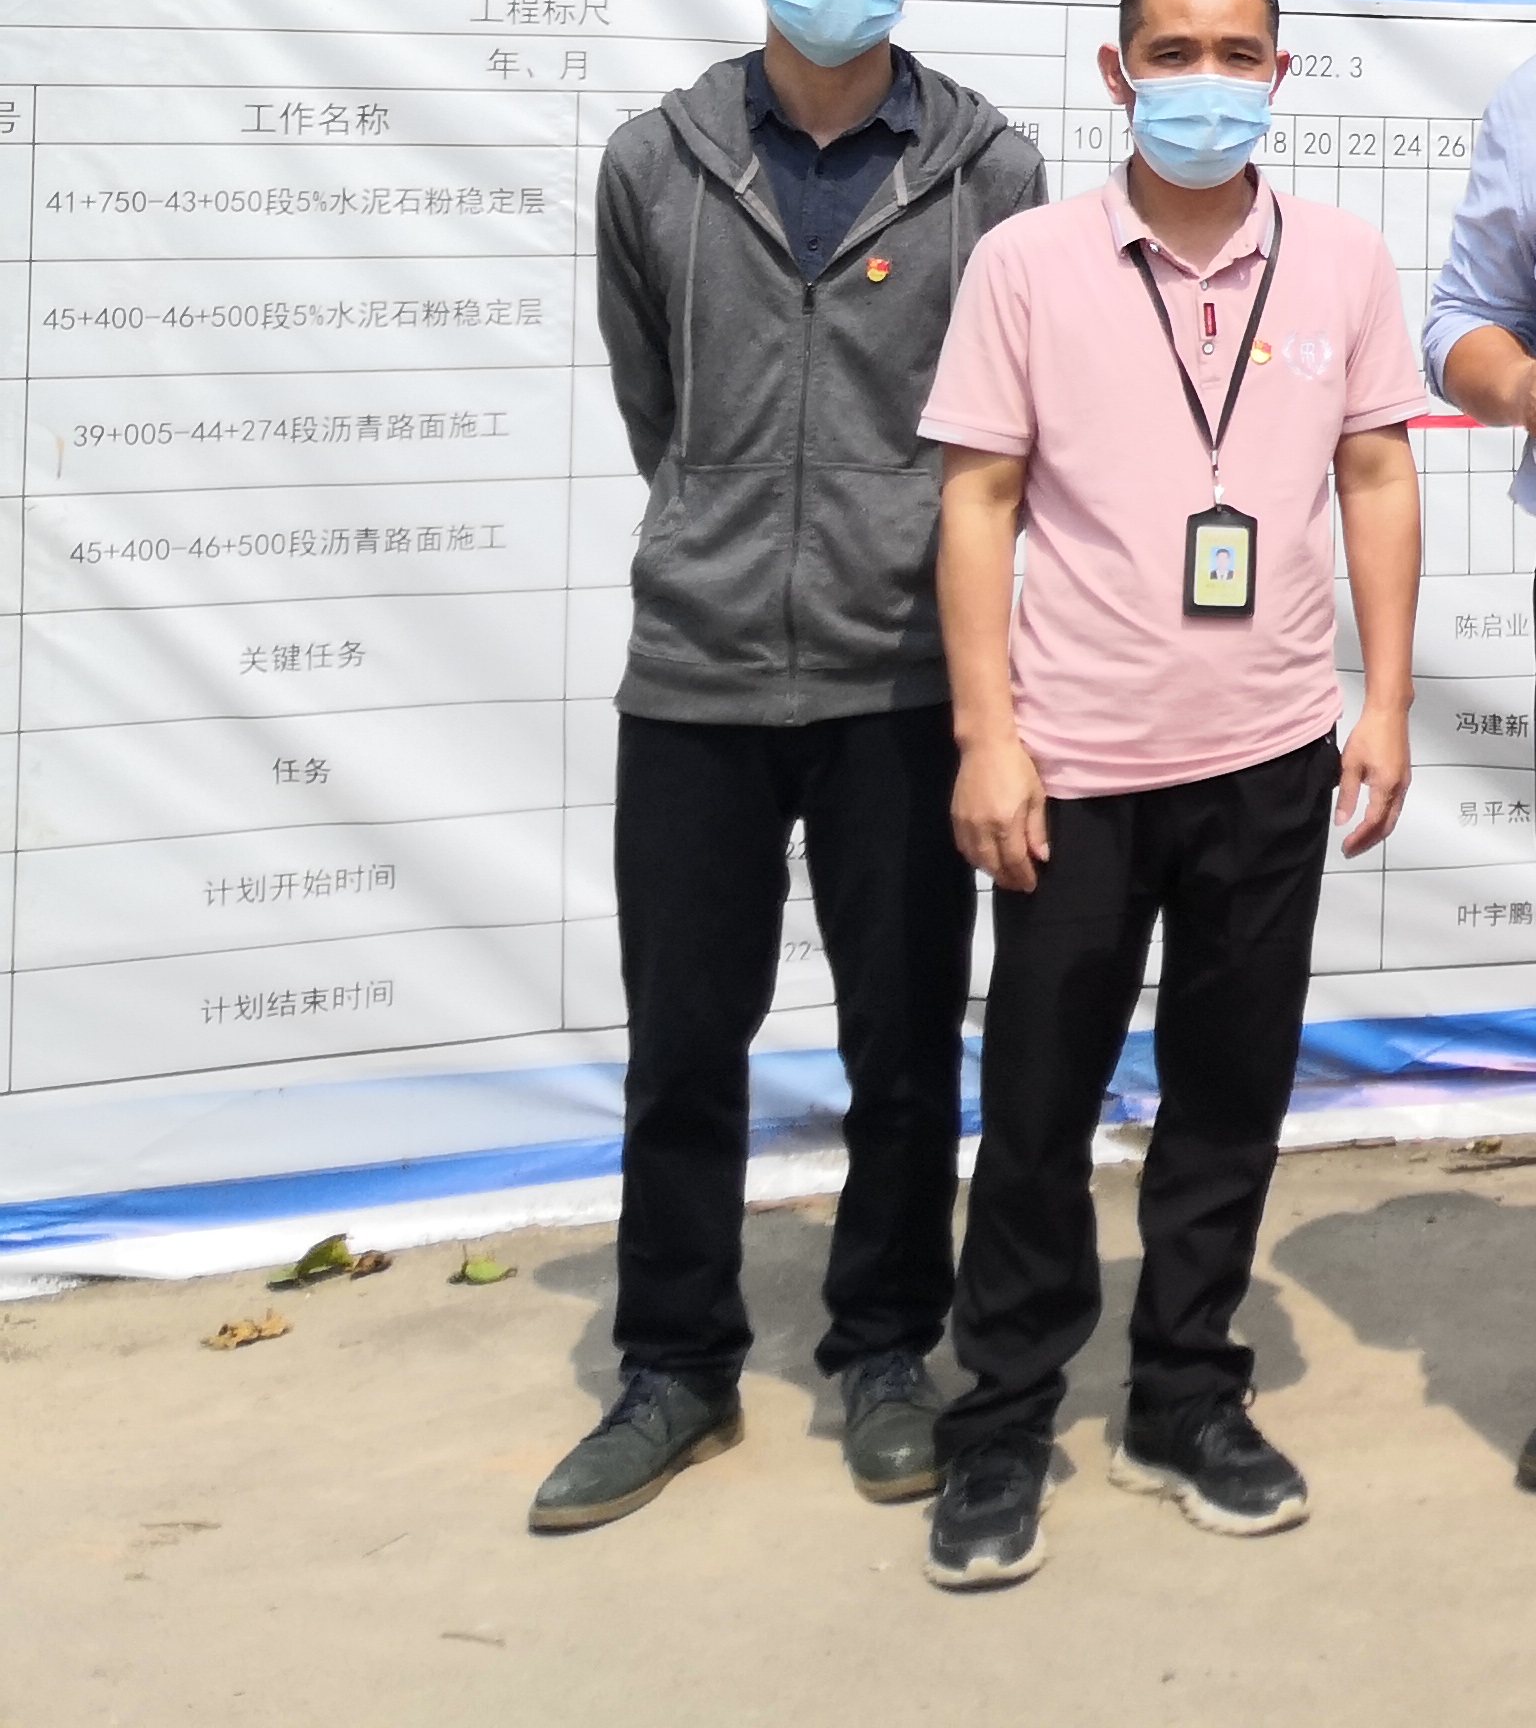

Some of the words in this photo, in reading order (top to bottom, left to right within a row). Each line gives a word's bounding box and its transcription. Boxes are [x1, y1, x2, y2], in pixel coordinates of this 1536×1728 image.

[487, 49, 590, 82] 年、月
[1288, 54, 1364, 79] 022.3
[241, 103, 390, 137] 工作名称
[1074, 126, 1103, 150] 10
[1304, 132, 1332, 155] 20
[1348, 133, 1377, 156] 22
[1393, 134, 1422, 157] 24
[1437, 134, 1467, 159] 26
[46, 187, 546, 218] 41+750-43+050段5%水泥石粉稳定层
[42, 300, 543, 332] 45+400-46+500段5%水泥石粉稳定层
[72, 411, 510, 449] 39+005-44+274段沥青路面施工
[69, 524, 507, 566] 45+400-46+500段沥青路面施工
[1455, 614, 1530, 639] 陈启业
[239, 639, 368, 675] 关键任务
[1456, 713, 1530, 739] 冯建新
[272, 757, 331, 787] 任务
[1458, 800, 1532, 827] 易平杰
[202, 864, 397, 908] 计划开始时间
[1457, 902, 1534, 927] 叶宇鹏
[201, 980, 396, 1026] 计划结束时间
